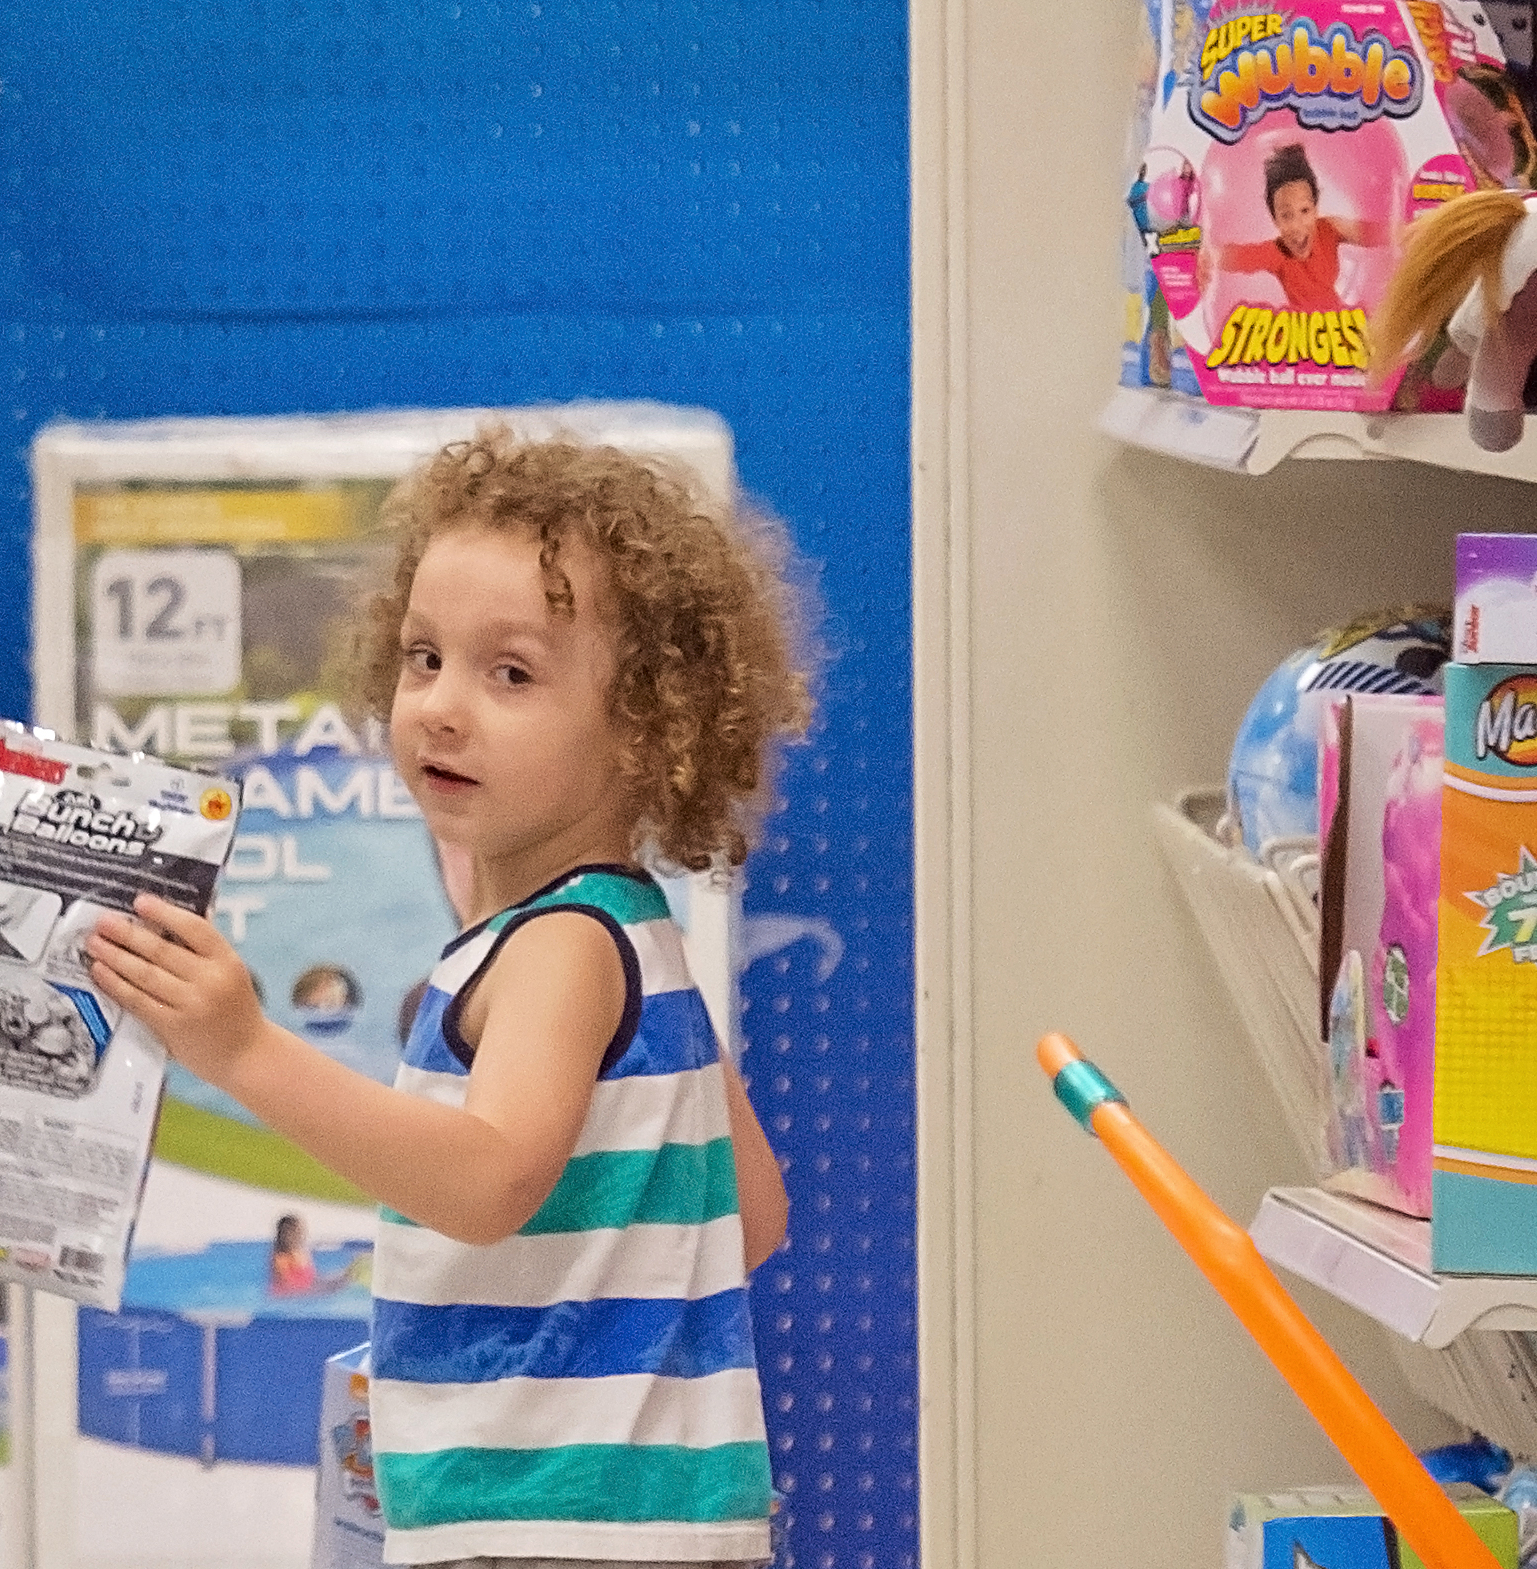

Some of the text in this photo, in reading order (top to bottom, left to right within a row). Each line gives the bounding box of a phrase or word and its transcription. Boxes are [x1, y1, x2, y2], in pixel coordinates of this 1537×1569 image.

[1200, 13, 1283, 81] SUPER
[1200, 27, 1411, 129] Wubble
[1206, 305, 1370, 368] STRONGES
[106, 576, 188, 642] 12
[15, 787, 136, 838] Bunch
[241, 767, 428, 820] AME
[10, 813, 147, 857] Balloons
[222, 832, 333, 882] OL
